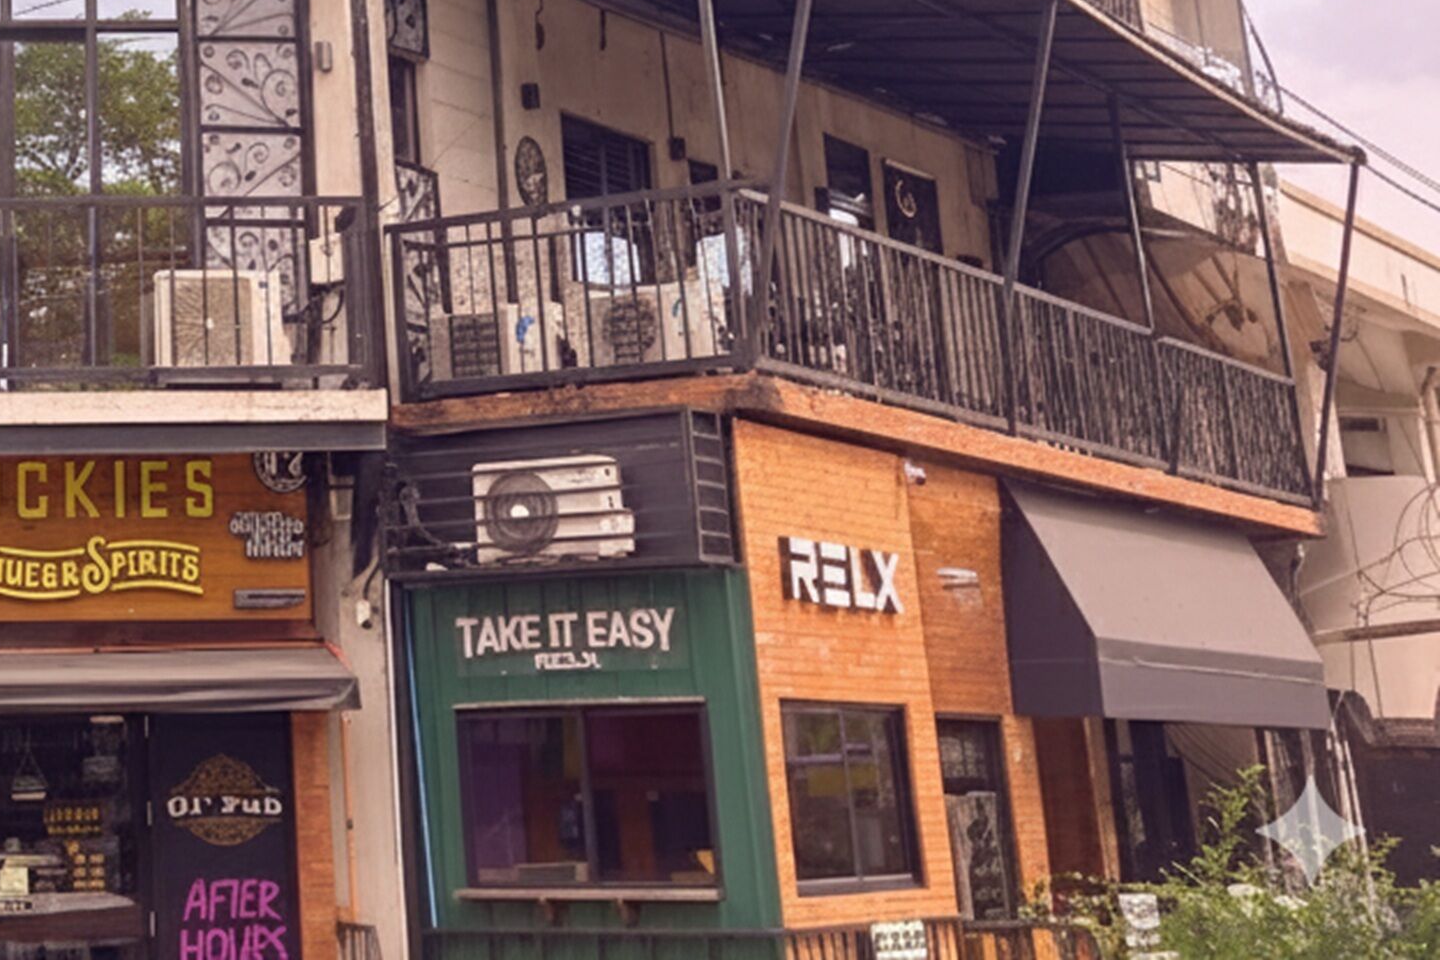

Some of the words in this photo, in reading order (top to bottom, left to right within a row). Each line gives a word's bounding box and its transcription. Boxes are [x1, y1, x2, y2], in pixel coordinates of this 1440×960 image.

[82, 535, 200, 594] SPIRITS
[786, 535, 905, 615] RELX
[455, 613, 542, 658] TAKE
[548, 612, 578, 647] IT
[586, 606, 675, 652] EASY
[182, 877, 283, 922] AFTER
